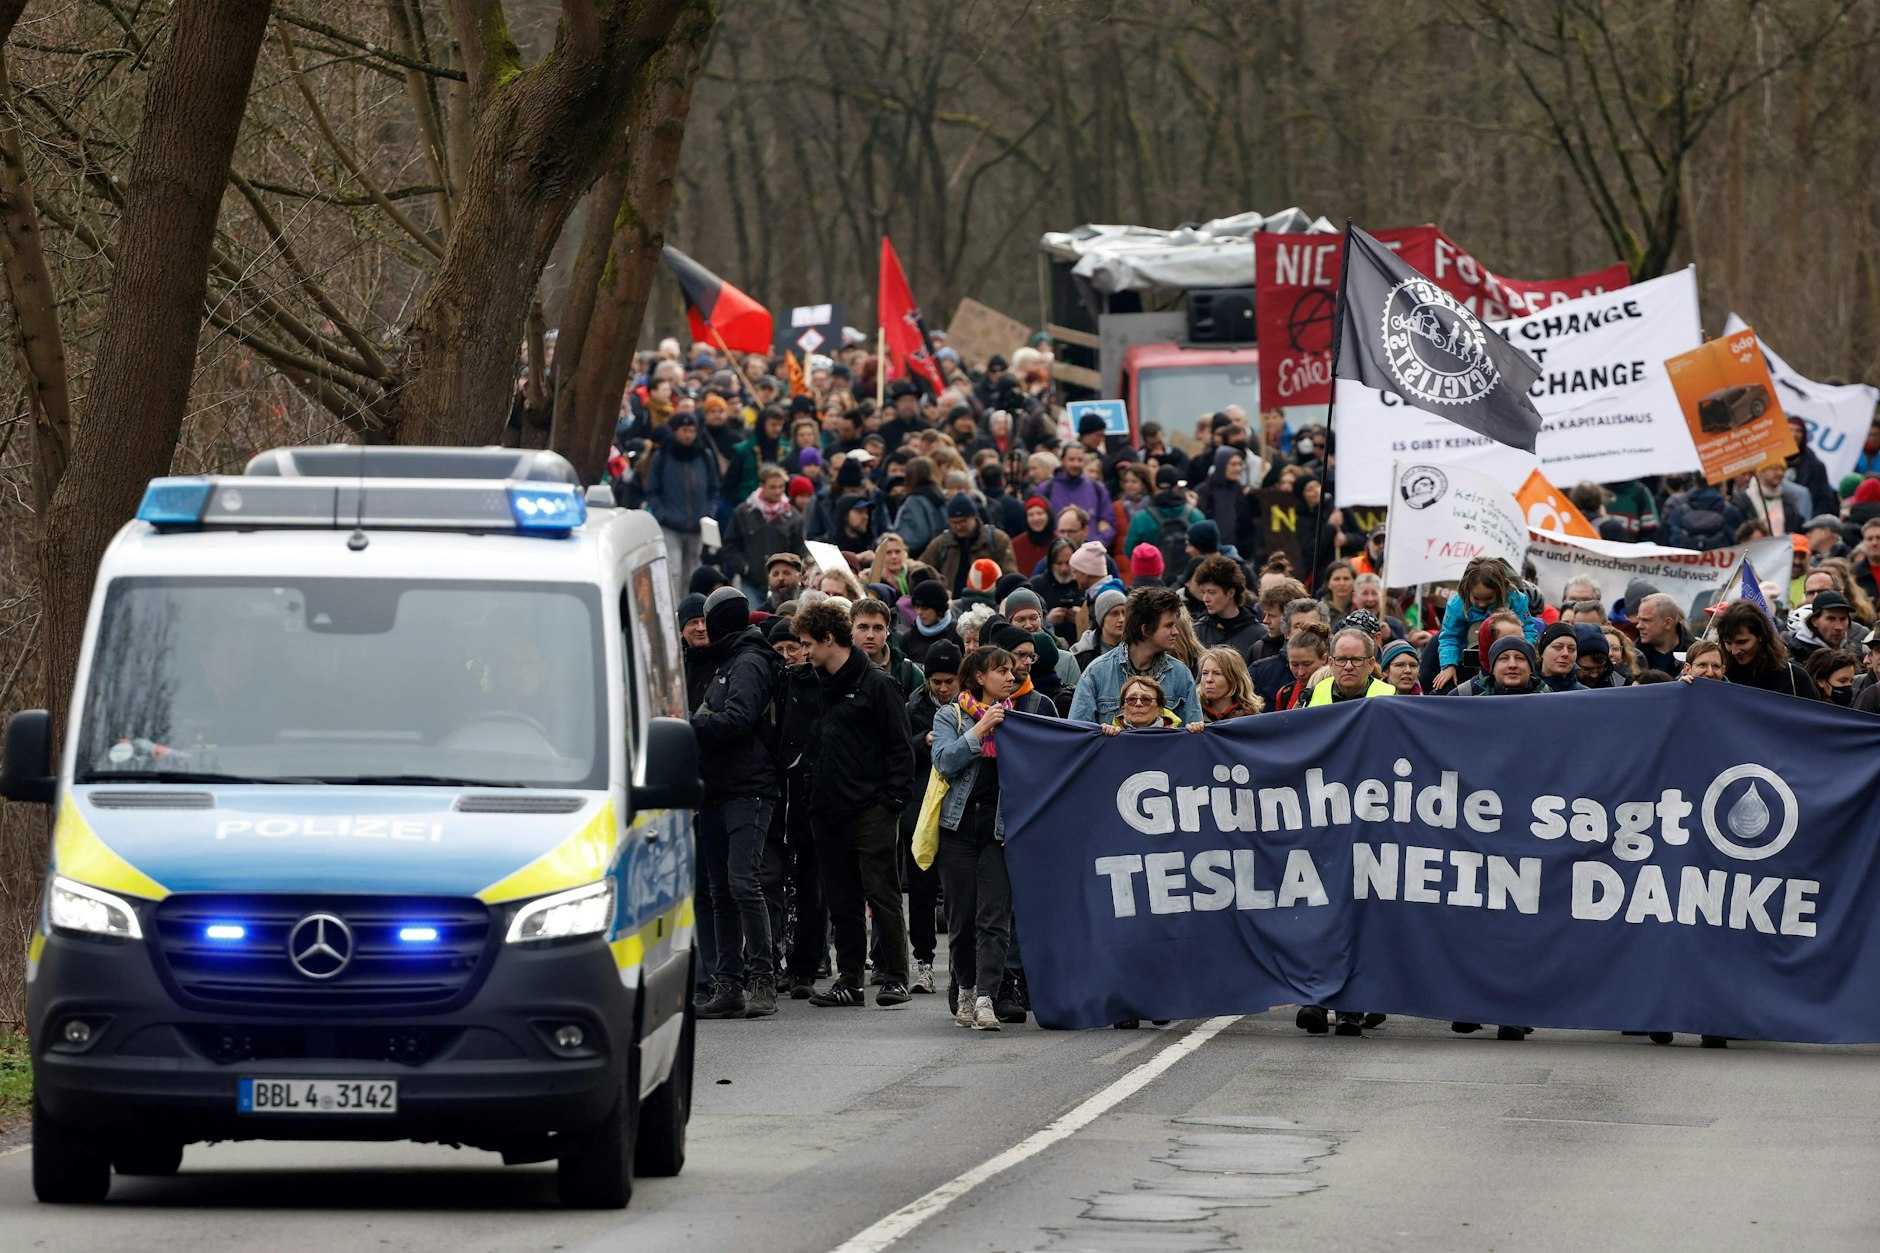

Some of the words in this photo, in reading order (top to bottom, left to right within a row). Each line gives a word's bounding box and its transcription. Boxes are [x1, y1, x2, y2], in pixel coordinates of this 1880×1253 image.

[1521, 301, 1642, 341] CHANGE
[1278, 350, 1333, 397] Entei
[1528, 361, 1646, 397] CHANGE
[1440, 541, 1485, 558] NEIN
[1546, 551, 1572, 562] und
[1573, 553, 1637, 573] Menschen
[1639, 564, 1661, 575] auf
[1116, 758, 1503, 835] Grünheide
[1530, 788, 1693, 861] sagt
[215, 817, 443, 843] POLIZEI
[1095, 849, 1330, 918] TESLA
[1353, 842, 1542, 914] NEIN
[1571, 860, 1820, 937] DANKE
[256, 1084, 298, 1107] BBL
[305, 1084, 317, 1107] 4
[337, 1084, 393, 1108] 3142
